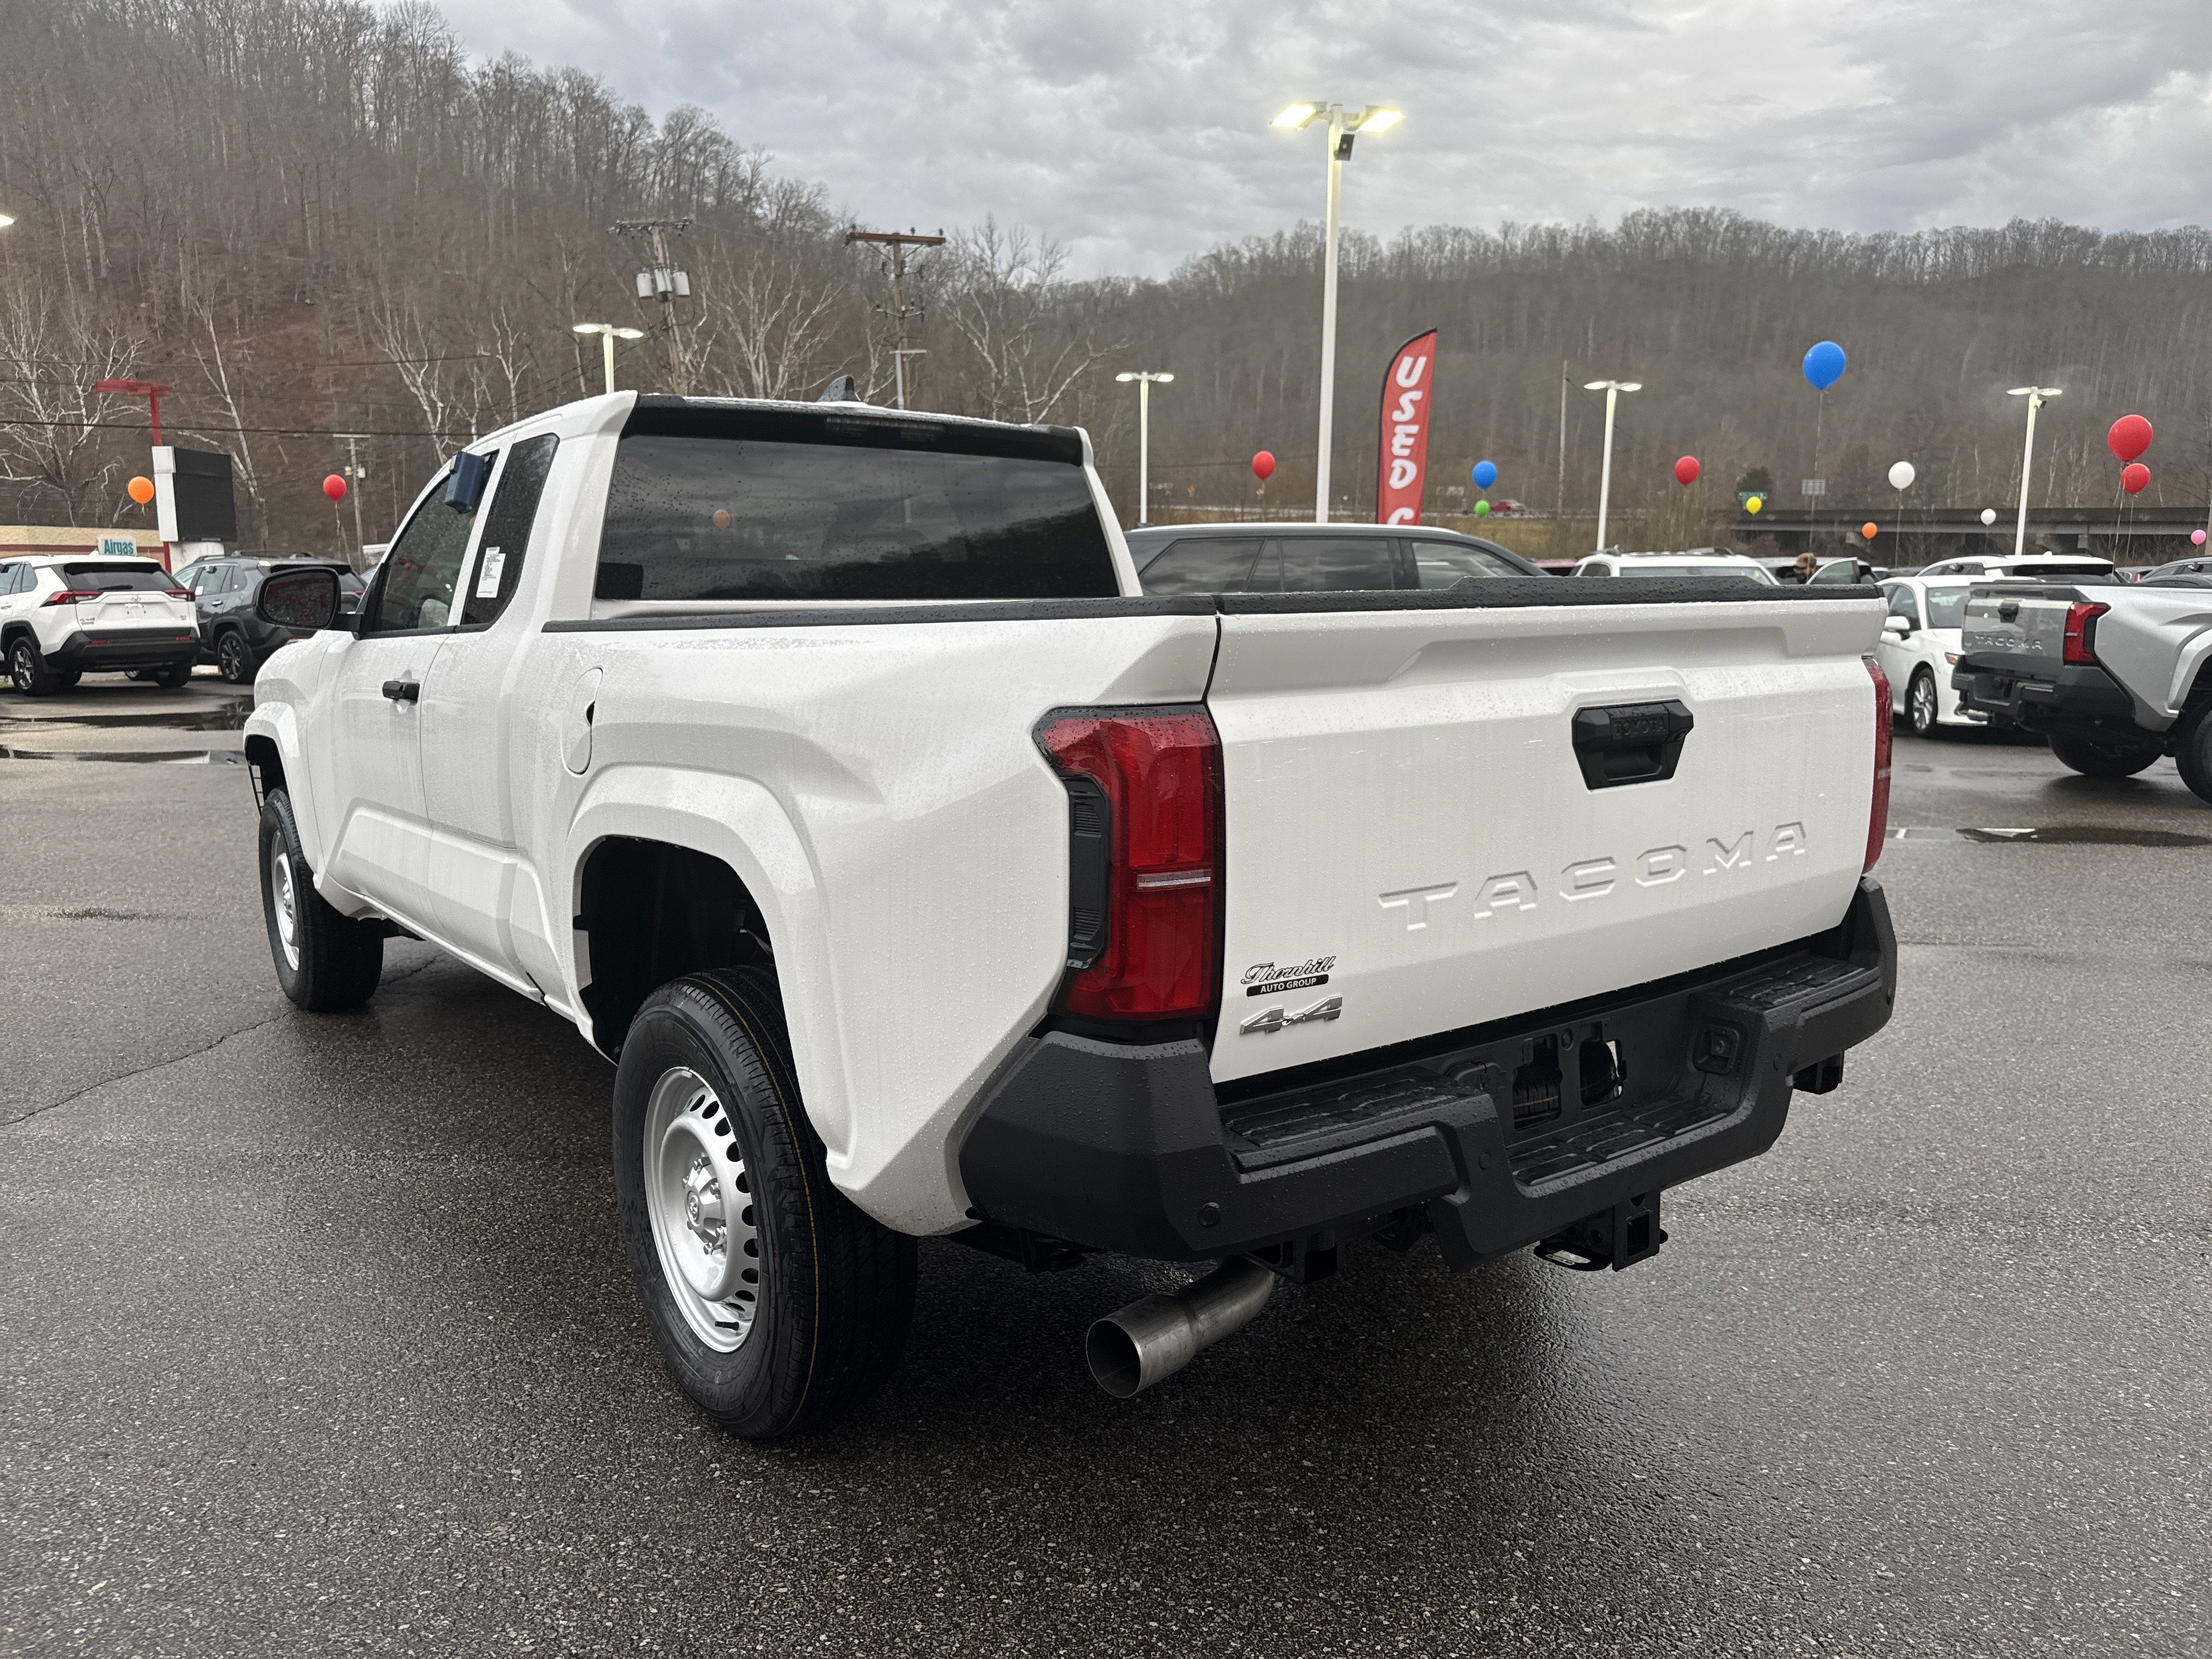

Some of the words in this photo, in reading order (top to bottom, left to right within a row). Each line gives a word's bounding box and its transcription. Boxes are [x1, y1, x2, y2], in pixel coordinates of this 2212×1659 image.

[1389, 356, 1427, 490] USED
[104, 539, 134, 554] Airgas
[1975, 634, 2042, 650] TACOMA
[1613, 715, 1667, 736] TOYOTA
[1378, 821, 1807, 931] TACOMA
[1240, 956, 1336, 984] Thornhill
[1260, 983, 1285, 994] AUTO
[1286, 977, 1317, 989] GROUP
